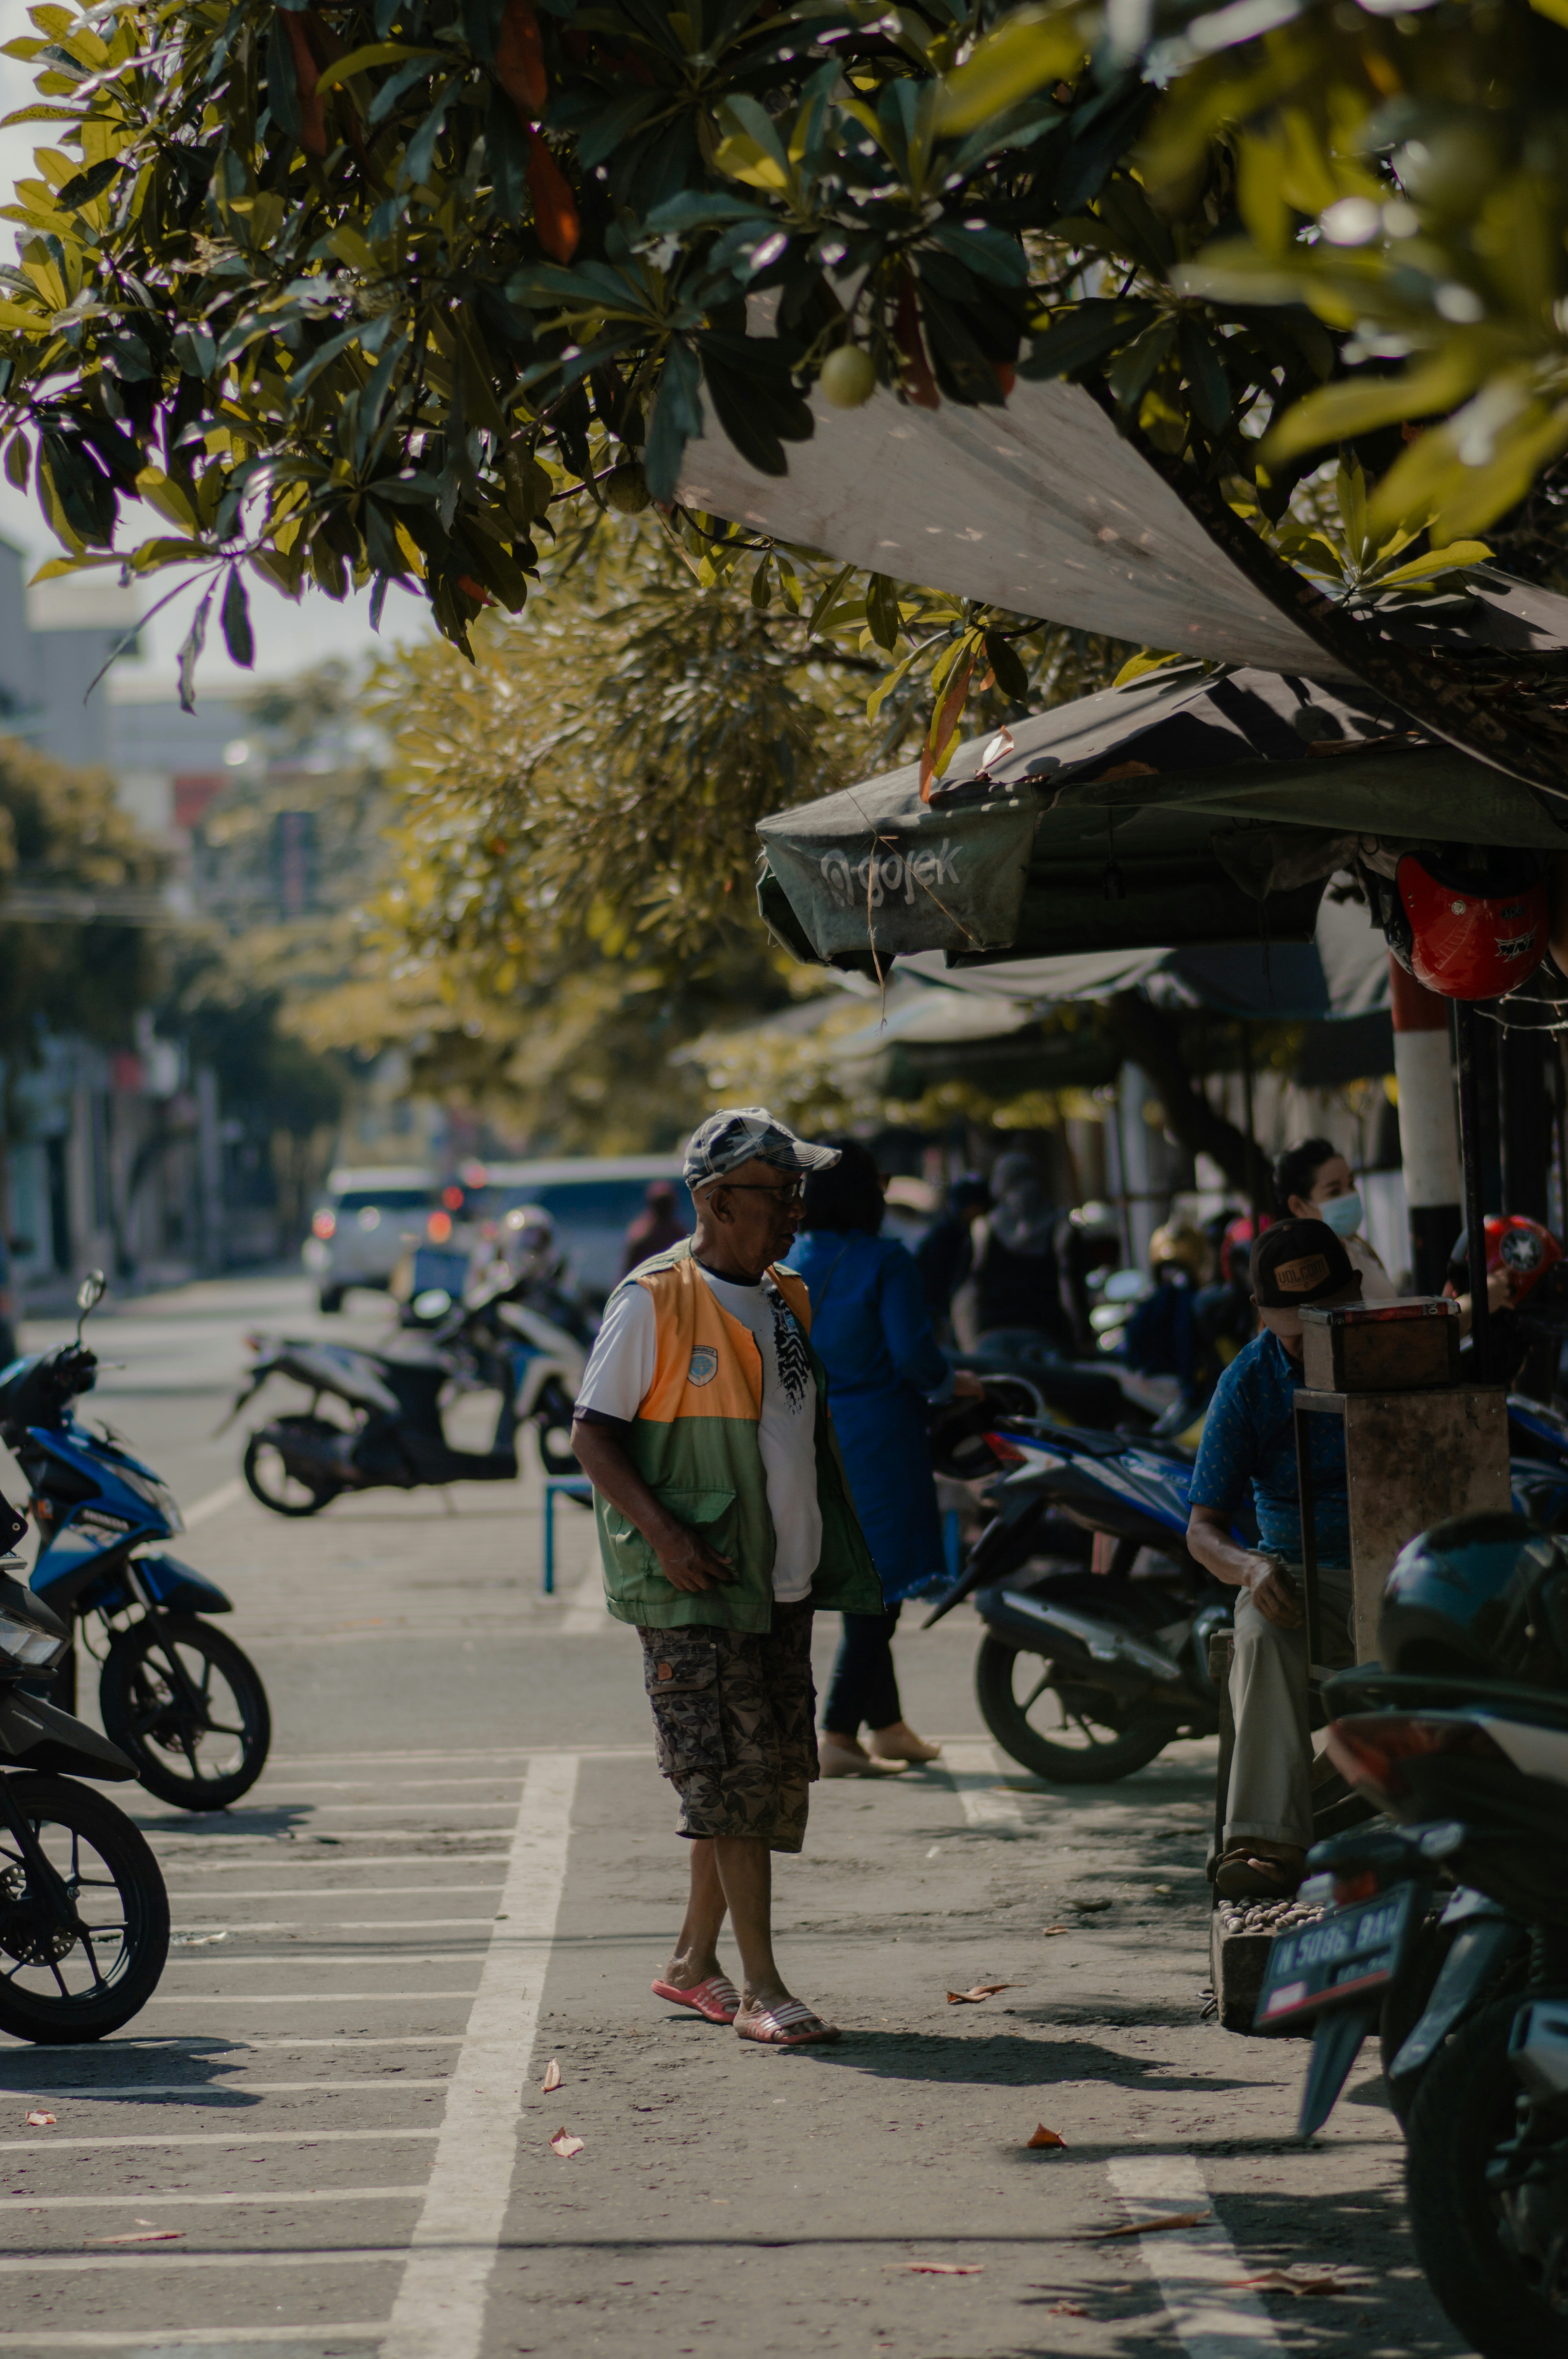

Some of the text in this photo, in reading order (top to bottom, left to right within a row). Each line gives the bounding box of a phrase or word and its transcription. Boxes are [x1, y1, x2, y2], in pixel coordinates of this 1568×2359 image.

[858, 837, 963, 907] gojek
[1504, 907, 1522, 918] DOT
[1278, 1259, 1325, 1284] VOLCOM
